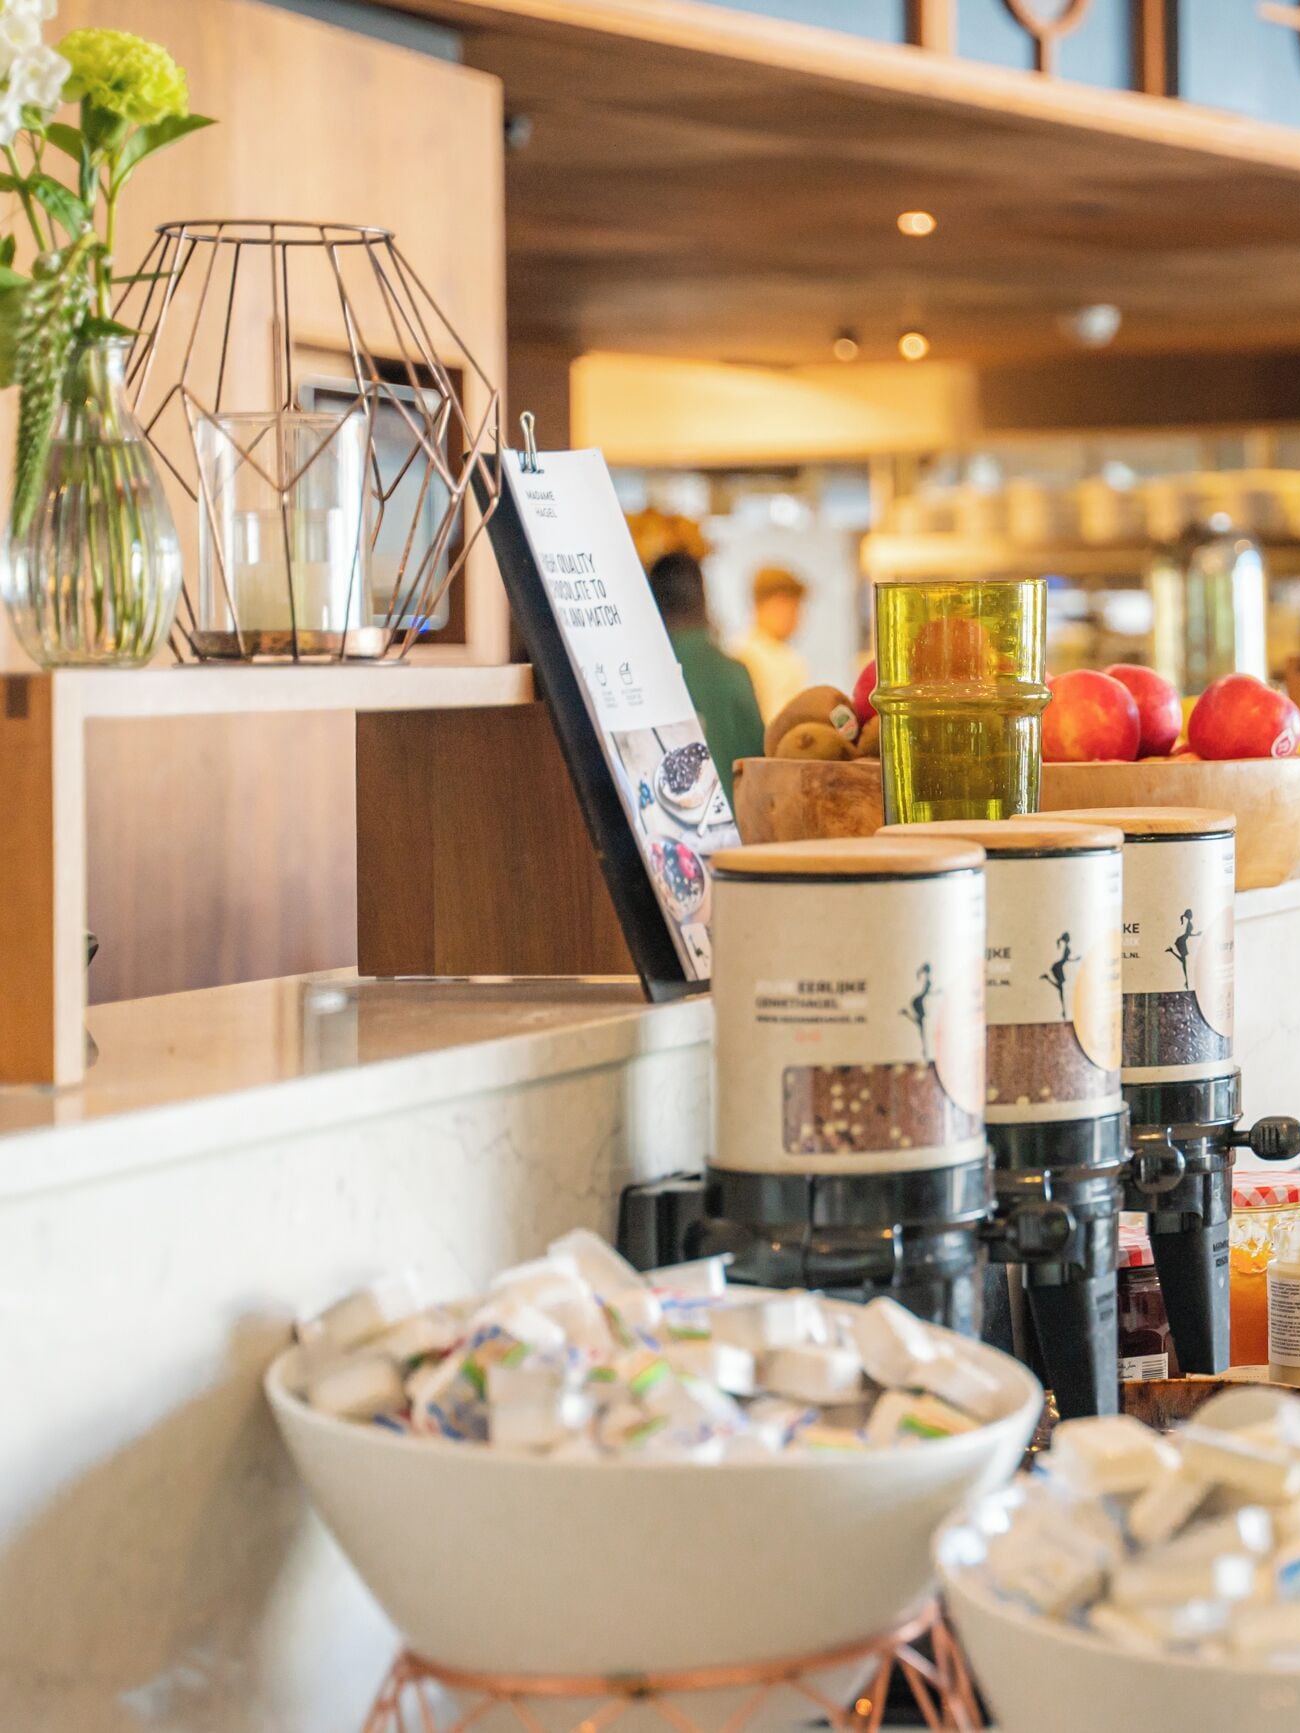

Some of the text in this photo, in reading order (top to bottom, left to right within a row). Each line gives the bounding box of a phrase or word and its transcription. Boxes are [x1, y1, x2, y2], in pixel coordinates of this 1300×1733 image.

[556, 552, 596, 574] QUALITY
[592, 578, 607, 600] TO
[584, 604, 622, 627] MATCH
